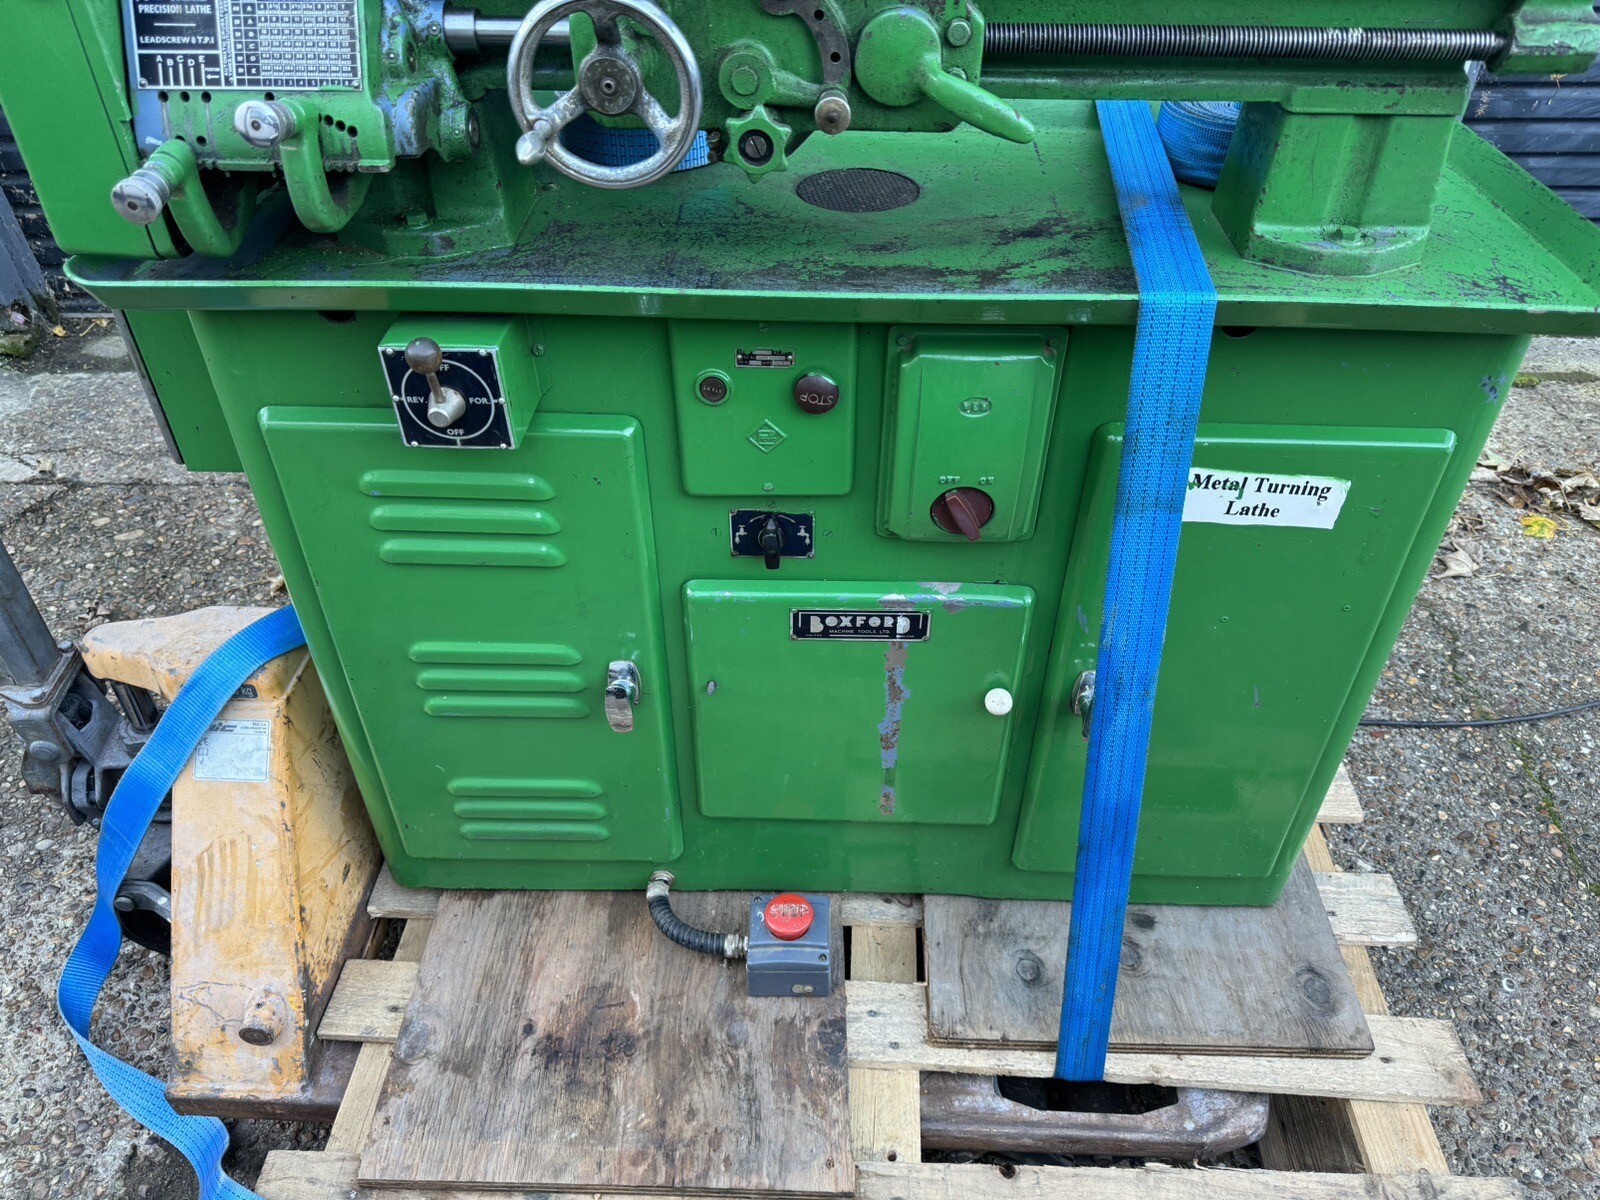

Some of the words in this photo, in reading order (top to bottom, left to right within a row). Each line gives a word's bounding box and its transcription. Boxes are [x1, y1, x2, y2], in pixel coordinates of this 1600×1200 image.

[138, 4, 182, 14] PRECISION
[185, 4, 212, 14] LATHE
[140, 36, 190, 44] LEADSCREW
[407, 396, 428, 404] REV.
[469, 397, 491, 405] FOR.
[800, 392, 834, 406] STOP
[447, 428, 465, 436] OFF
[939, 475, 960, 485] OFF
[979, 476, 994, 485] ON
[1192, 473, 1249, 491] Metal
[1254, 476, 1332, 502] Turning
[1223, 500, 1280, 518] Lathe
[810, 615, 911, 634] BOXFORD
[241, 687, 253, 697] kg
[769, 903, 809, 917] STOP
